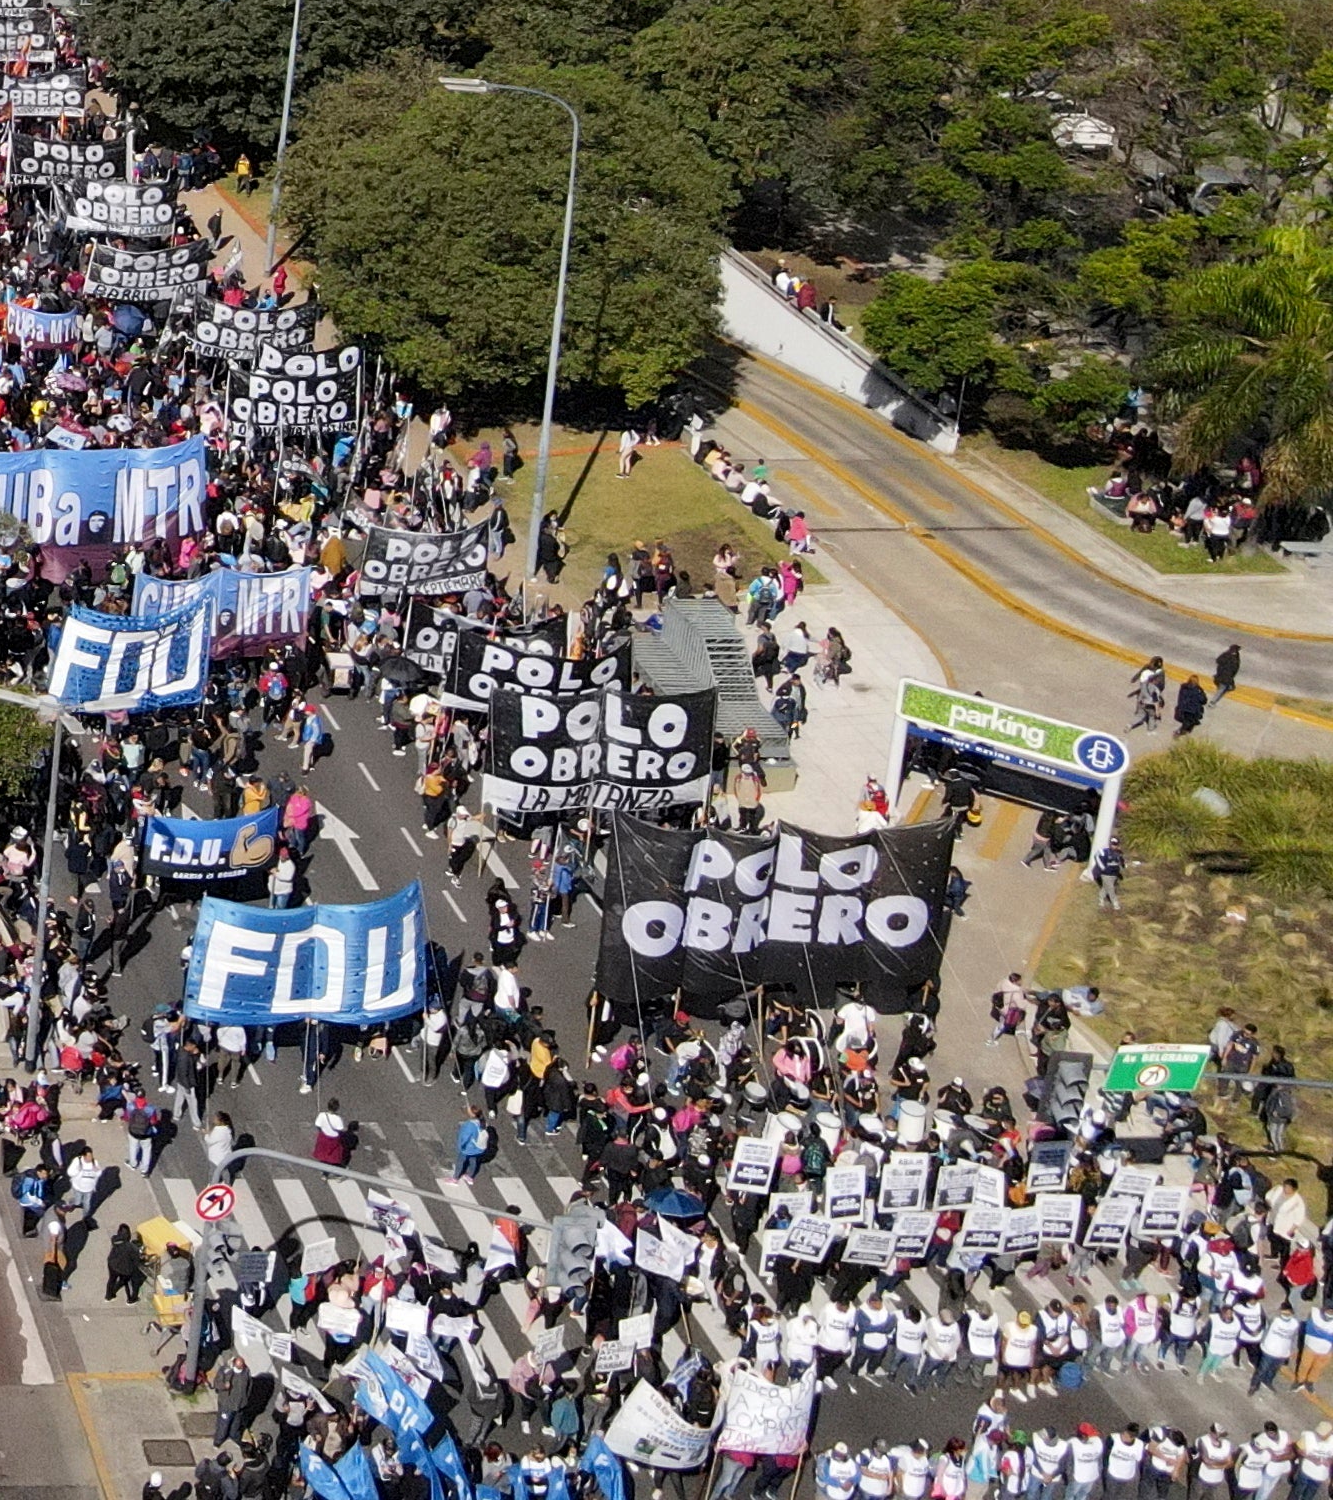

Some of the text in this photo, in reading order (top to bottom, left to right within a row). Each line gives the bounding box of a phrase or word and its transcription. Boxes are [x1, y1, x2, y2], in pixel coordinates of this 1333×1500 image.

[34, 141, 104, 162] POLO
[87, 182, 163, 206] POLO
[76, 198, 172, 225] OBRERO
[114, 249, 190, 272] POLO
[101, 263, 200, 288] OBRERO
[95, 284, 159, 302] BARRIO
[214, 303, 297, 332] POLO
[259, 344, 360, 378] POLO
[249, 375, 338, 404] POLO
[233, 398, 348, 425] OBRERO
[58, 434, 75, 446] MTR
[112, 458, 204, 543] MTR
[414, 572, 485, 596] SEPTIEMBRE
[236, 577, 301, 636] MTR
[483, 644, 618, 690] POLO
[522, 693, 688, 751] POLO
[948, 704, 1047, 749] parking
[511, 742, 697, 782] OBRERO
[519, 780, 675, 812] LA MATANZA
[684, 833, 879, 897] POLO
[622, 895, 930, 958] OBRERO
[198, 910, 416, 1014] FDU
[1141, 1053, 1199, 1063] BELGRANO
